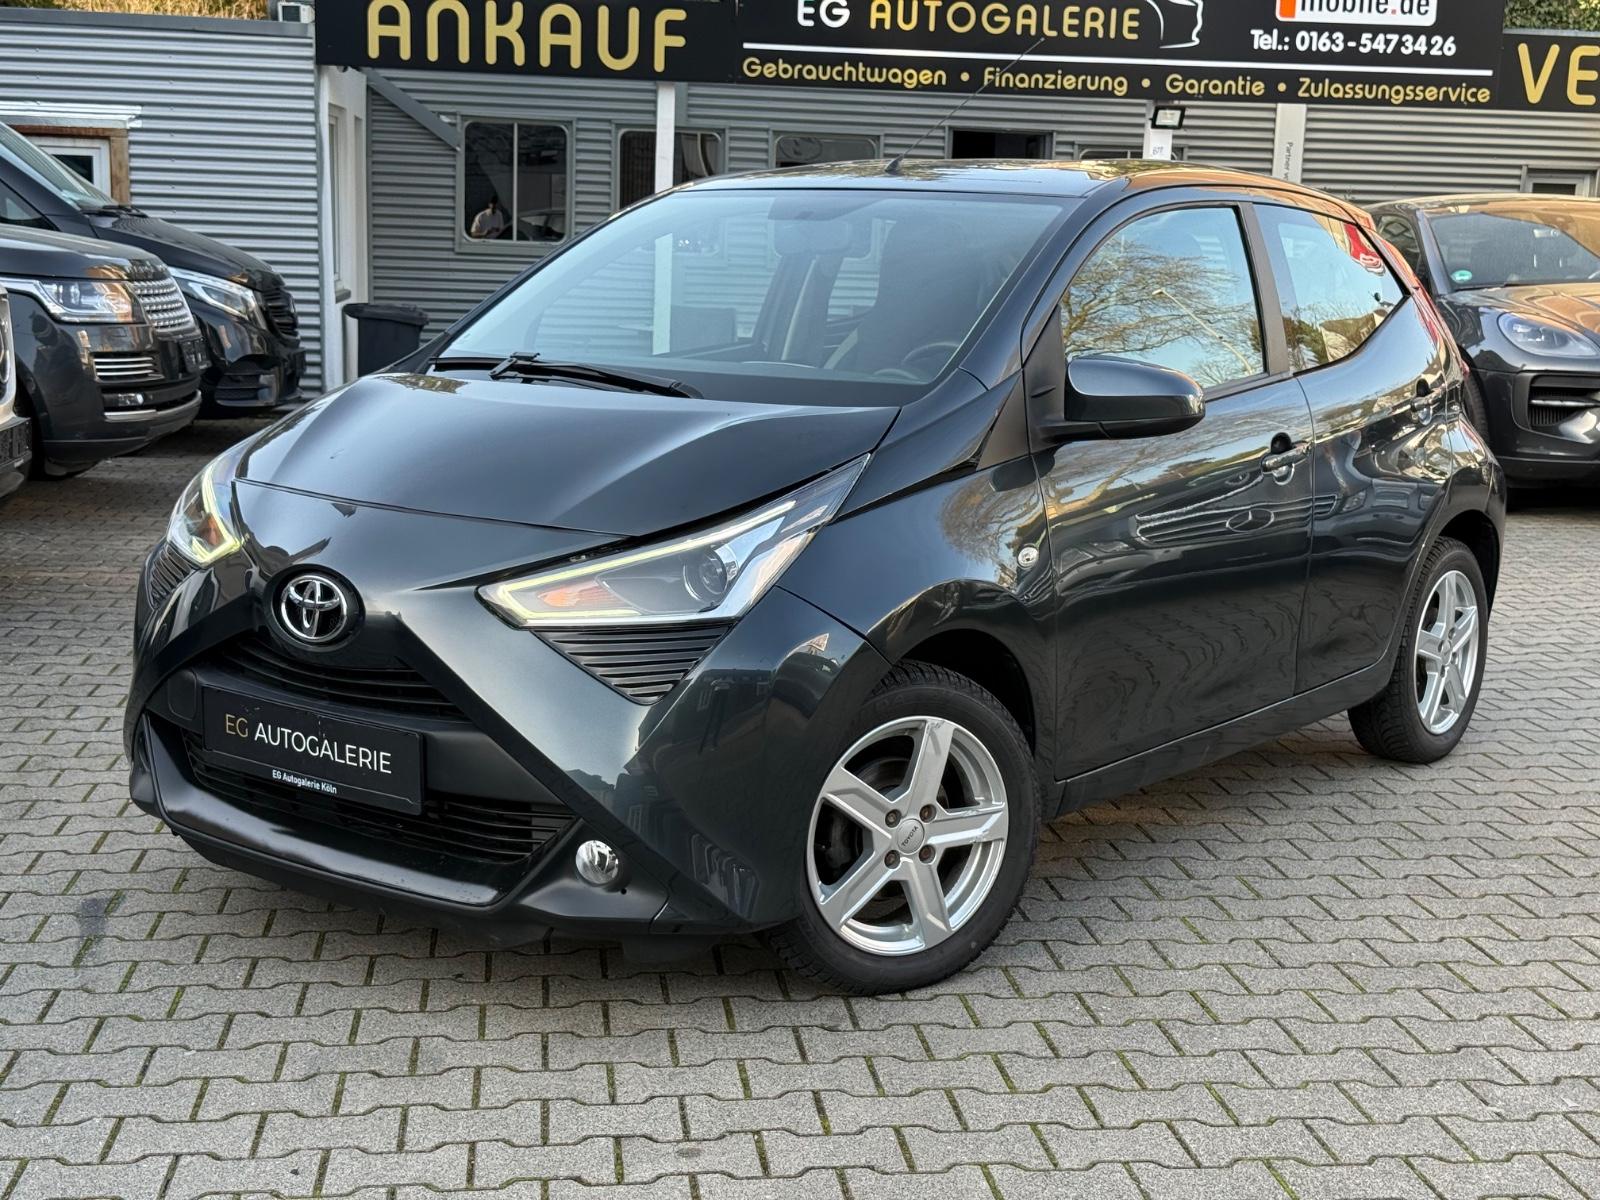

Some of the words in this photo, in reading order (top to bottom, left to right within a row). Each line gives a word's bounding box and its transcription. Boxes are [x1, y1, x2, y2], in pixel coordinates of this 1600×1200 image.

[797, 0, 850, 28] EG
[869, 0, 1140, 40] AUTOGALERIE
[1300, 0, 1430, 16] mobile.de
[367, 0, 687, 73] ANKAUF
[1250, 29, 1290, 51] Tel.:
[742, 57, 947, 89] Gebrauchtwagen
[983, 67, 1128, 96] Finanzierung
[1165, 73, 1265, 96] Garantie
[1297, 77, 1491, 104] Zulassungsservice
[225, 713, 249, 738] EG
[254, 722, 392, 774] AUTOGALERIE
[272, 769, 282, 780] EG
[282, 772, 321, 790] Autogalerie
[321, 782, 337, 794] Köln
[901, 826, 919, 847] TOYOTA
